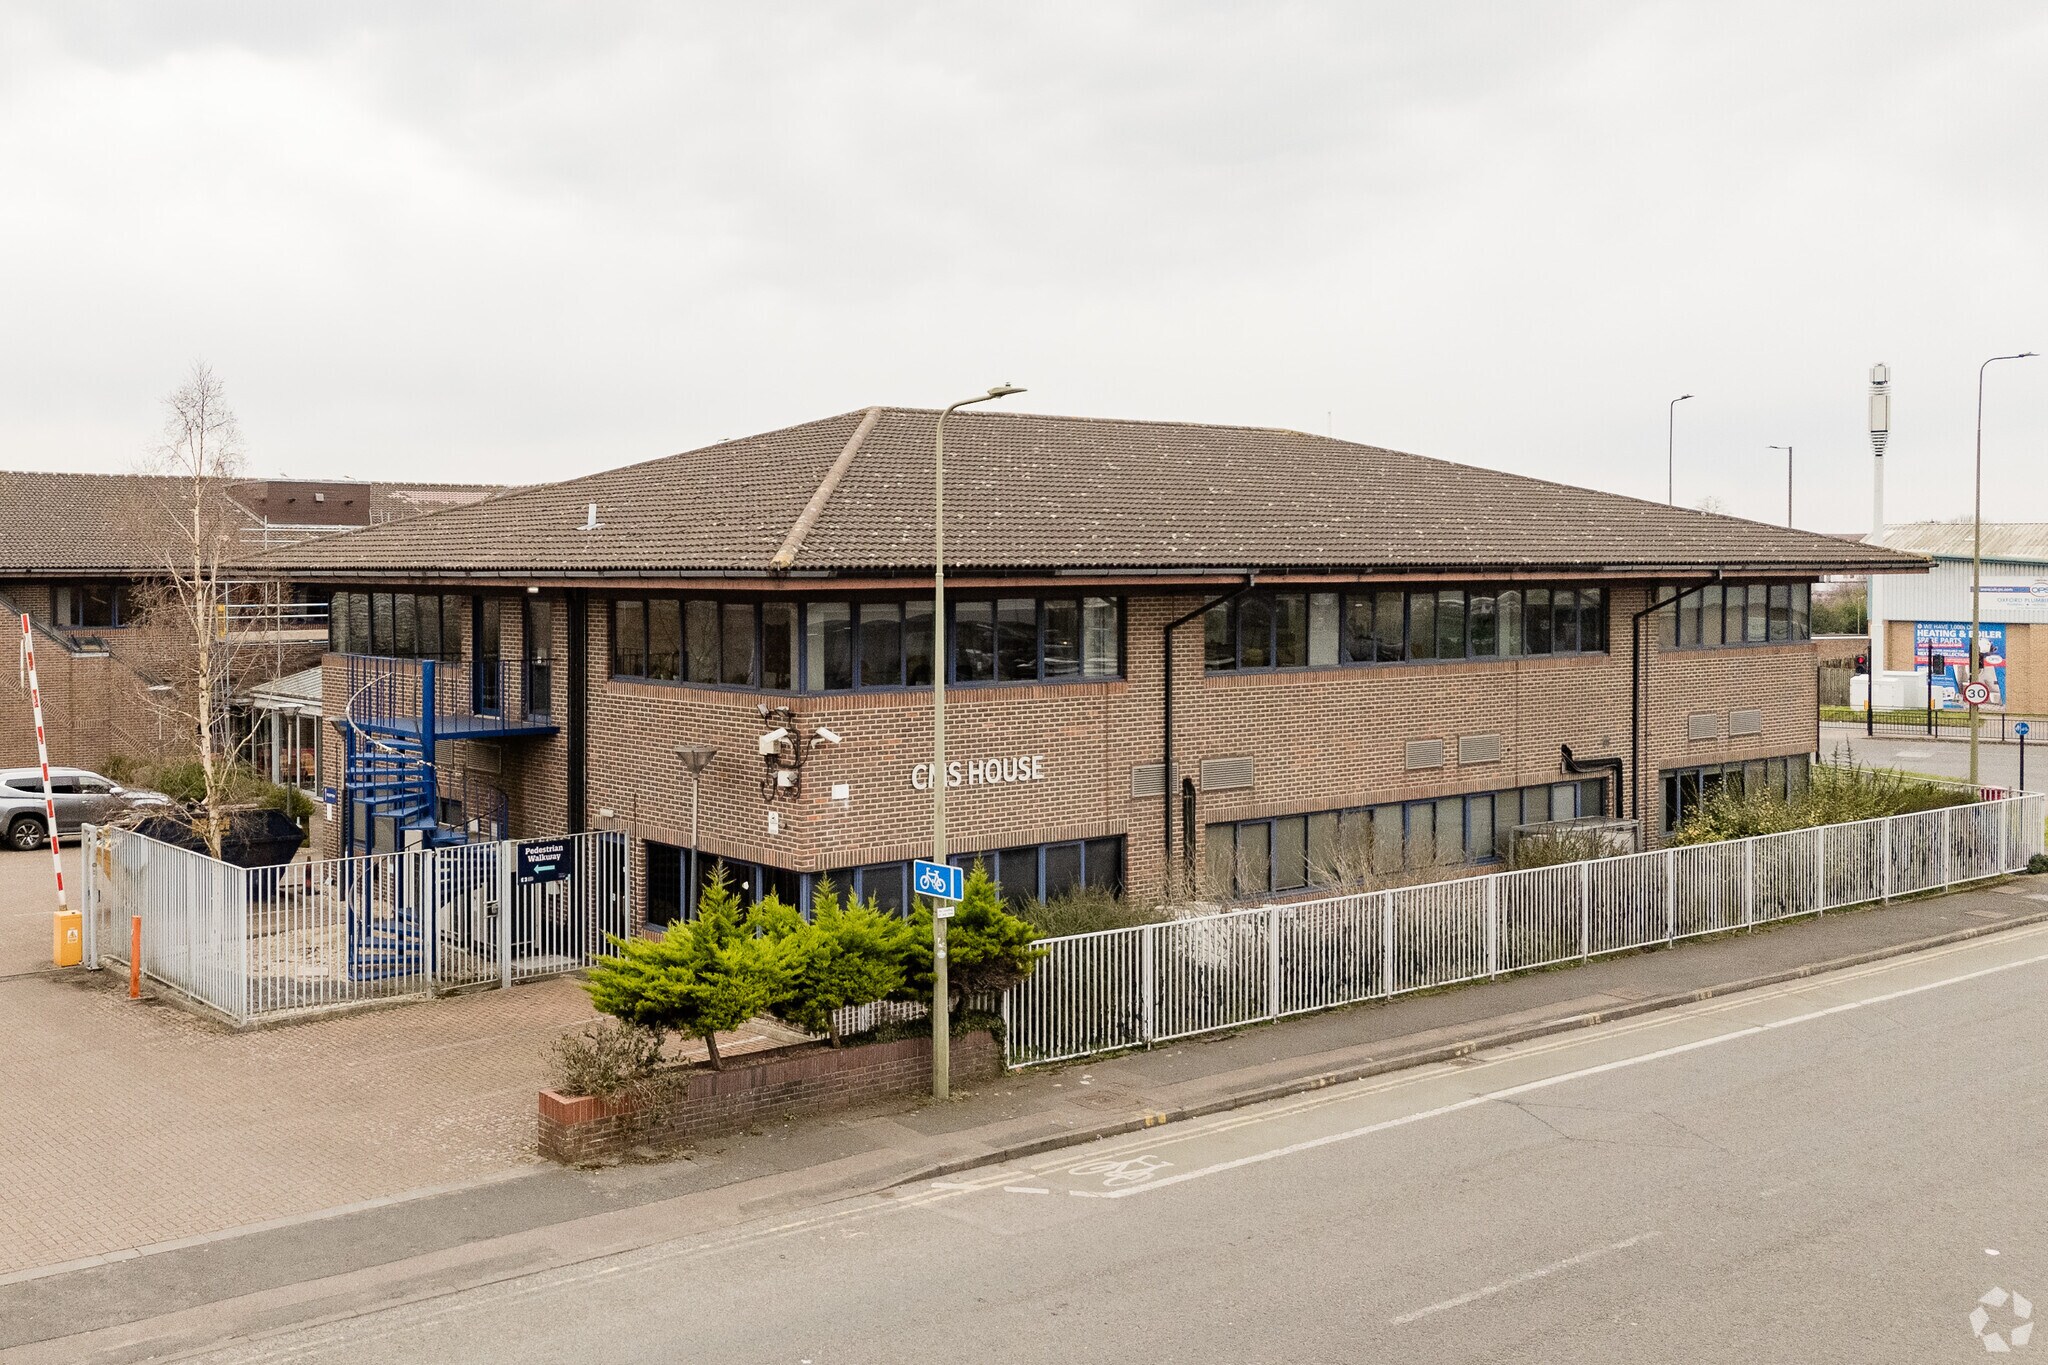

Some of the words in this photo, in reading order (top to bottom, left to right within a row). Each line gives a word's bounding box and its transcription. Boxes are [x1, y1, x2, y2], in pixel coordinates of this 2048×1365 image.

[1968, 689, 1986, 698] 30
[968, 755, 1044, 785] HOUSE
[525, 845, 564, 855] Pedestrian
[527, 854, 561, 863] Walkway
